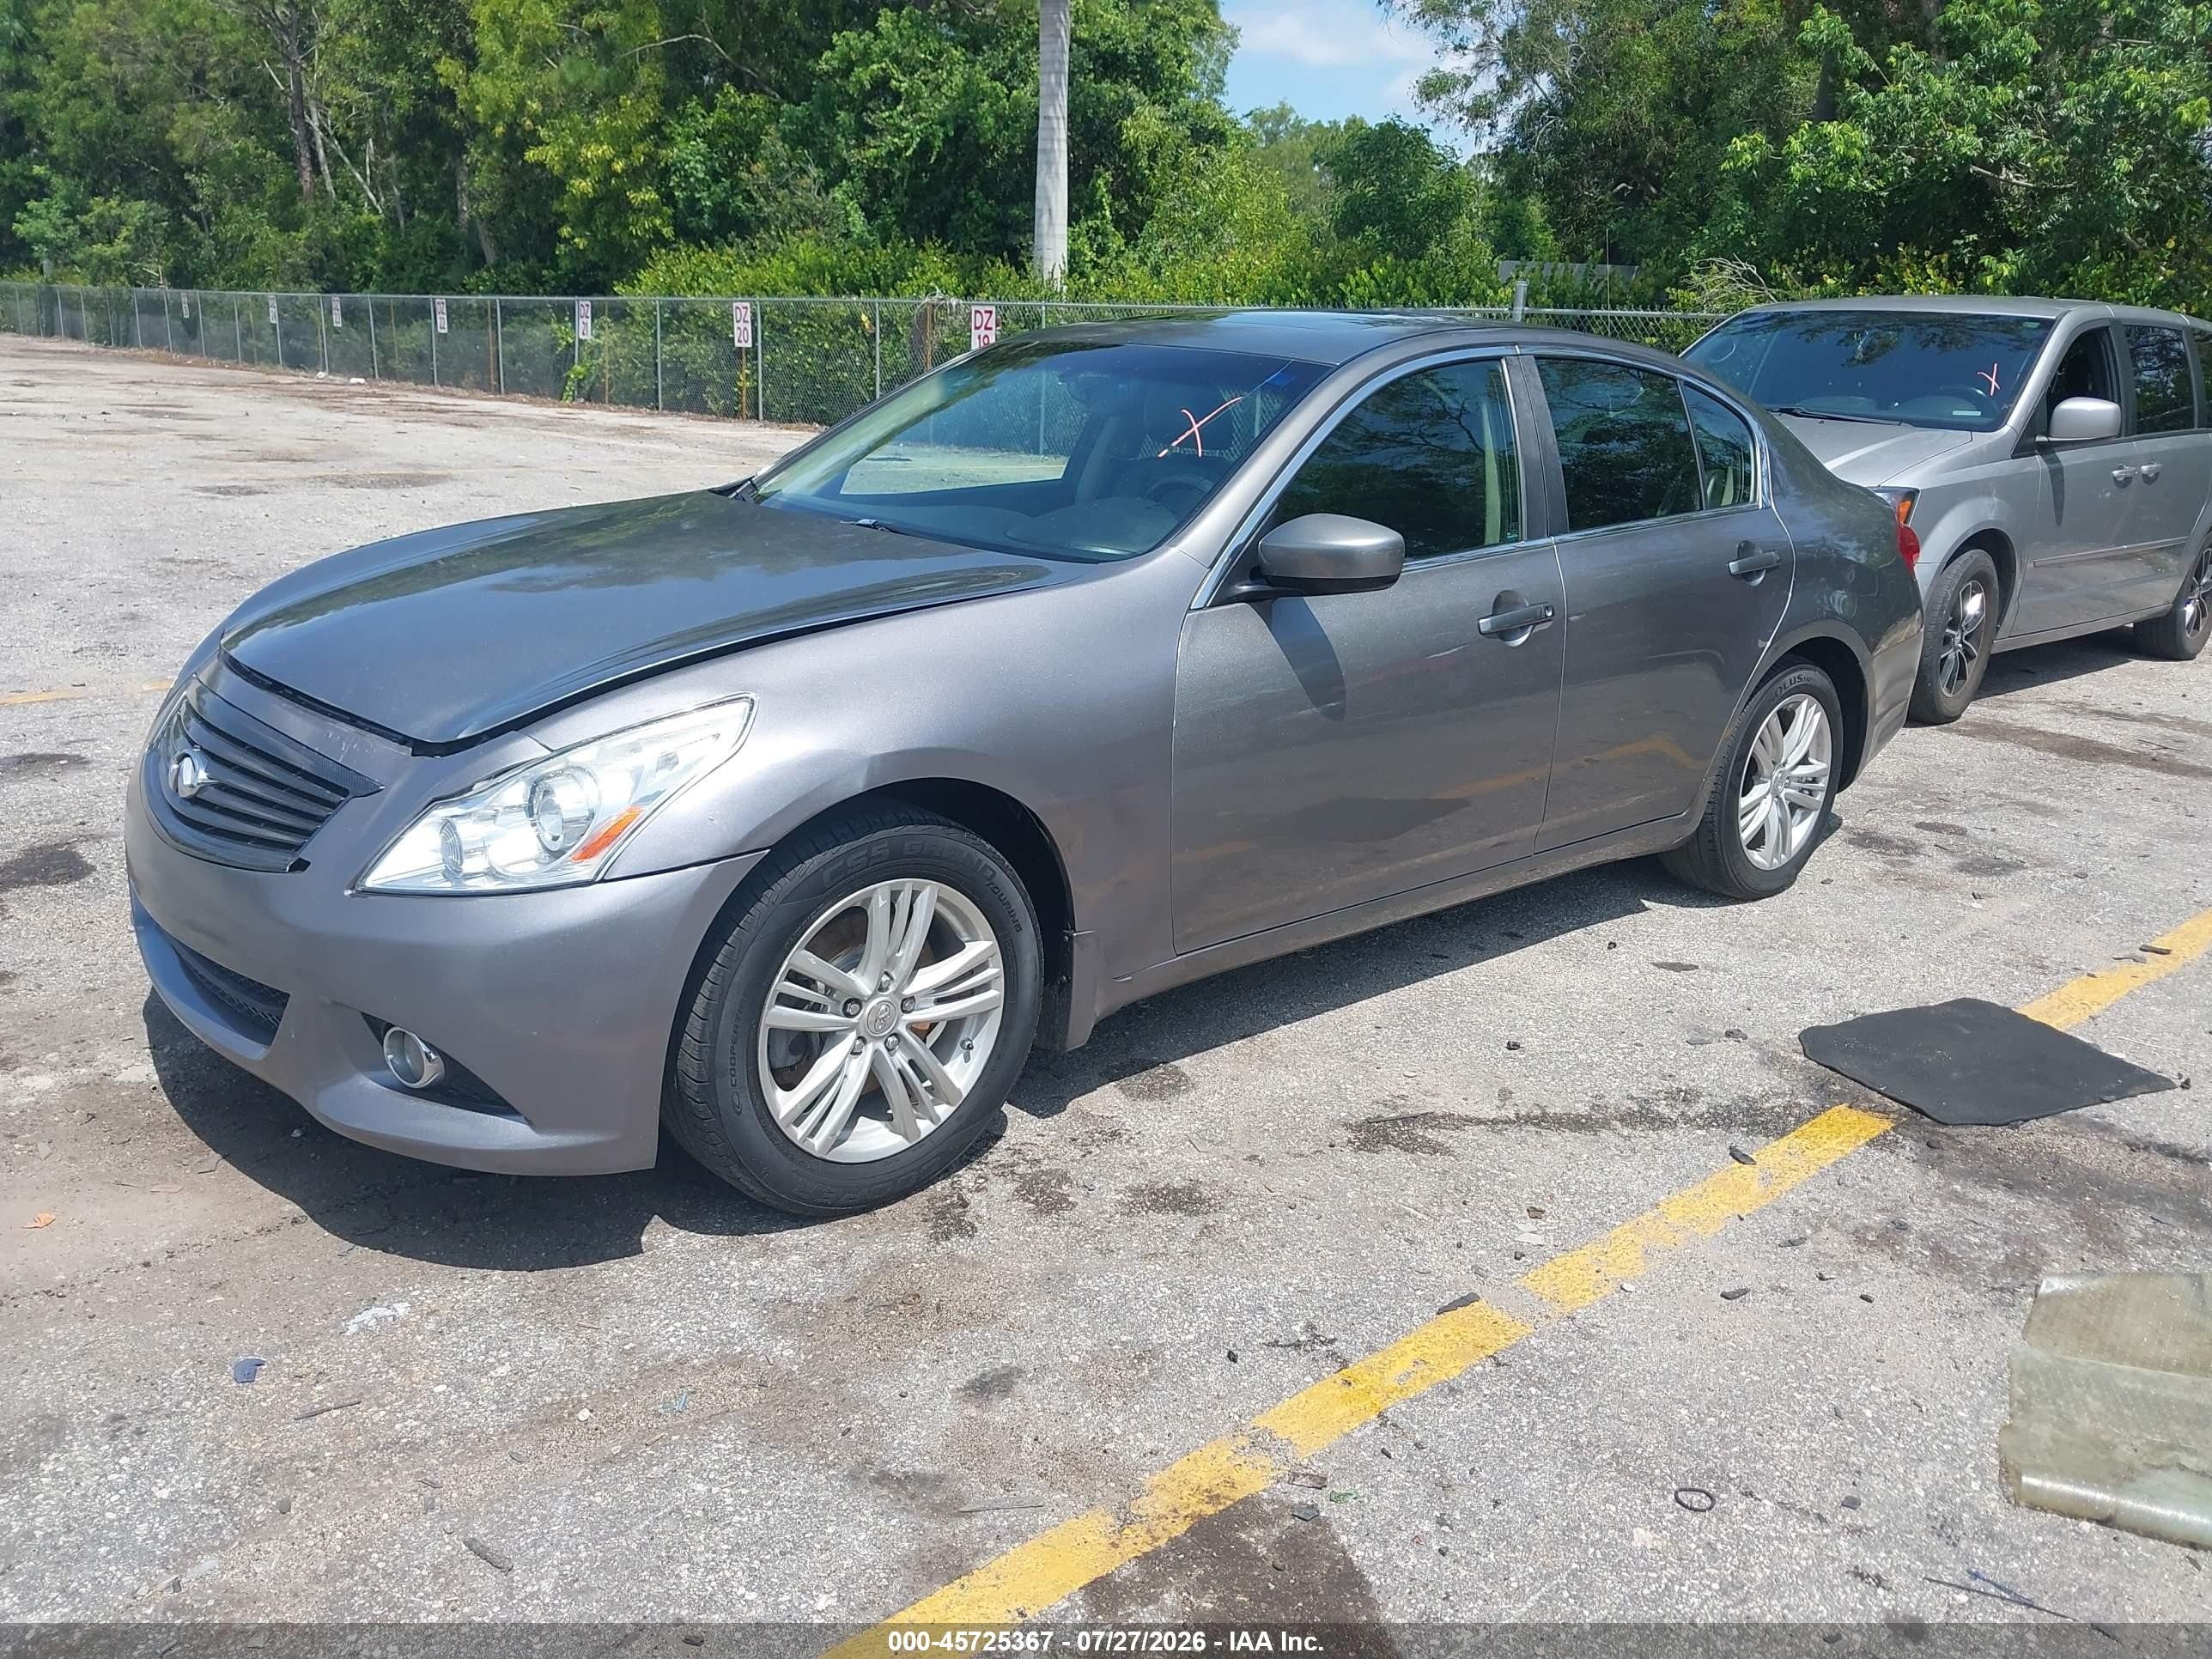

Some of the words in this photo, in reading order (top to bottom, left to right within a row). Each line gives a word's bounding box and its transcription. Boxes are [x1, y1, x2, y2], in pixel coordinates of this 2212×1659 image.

[580, 303, 590, 319] DZ
[735, 306, 750, 323] DZ
[581, 321, 589, 336] 21
[974, 310, 994, 331] DZ
[736, 326, 750, 343] 20
